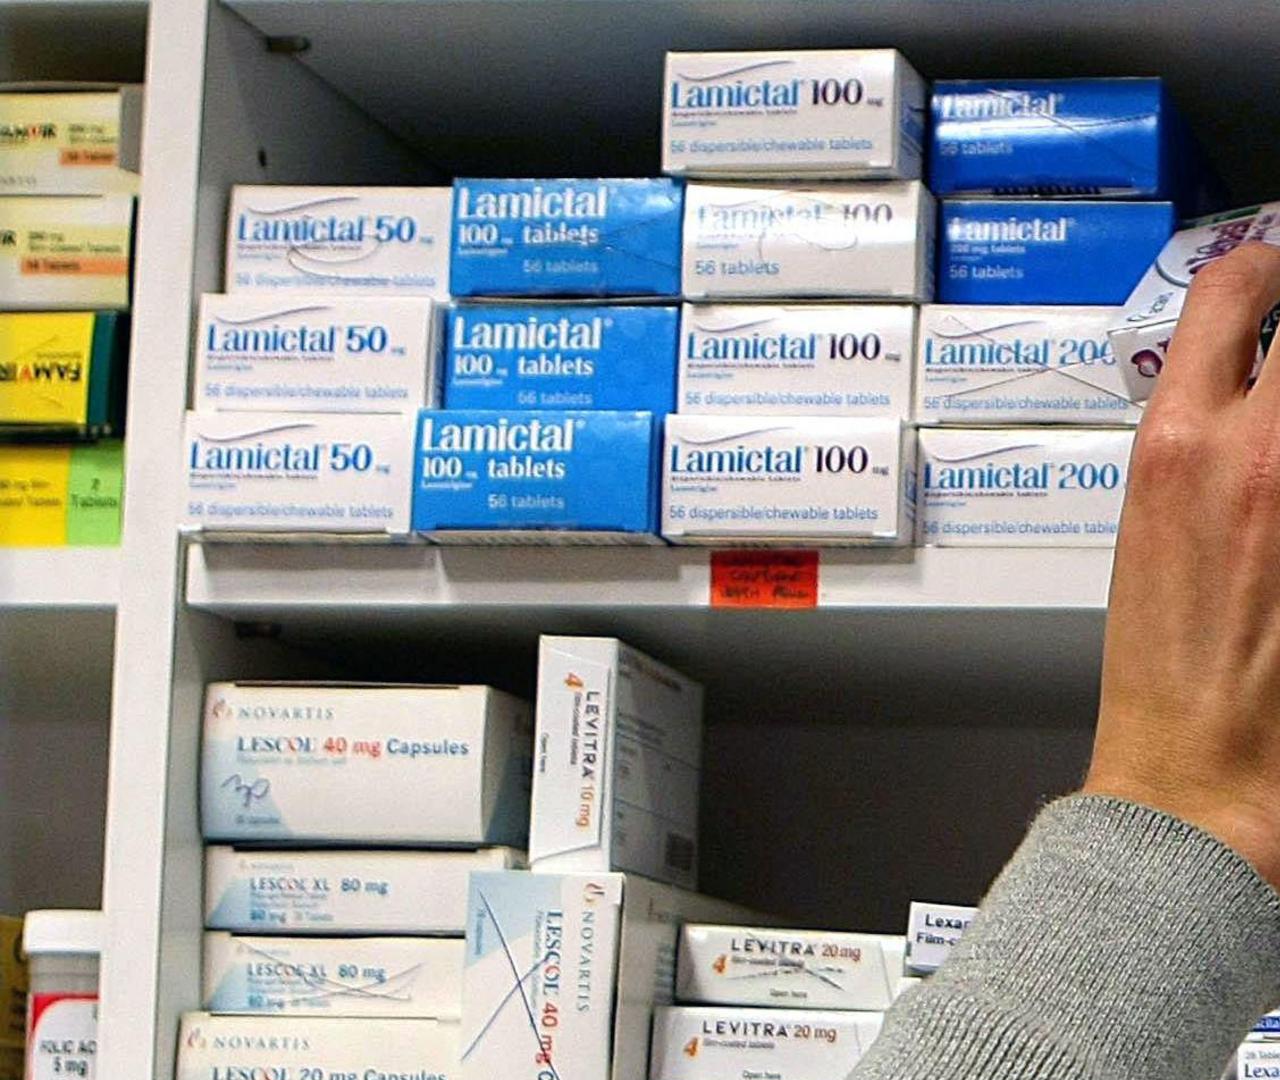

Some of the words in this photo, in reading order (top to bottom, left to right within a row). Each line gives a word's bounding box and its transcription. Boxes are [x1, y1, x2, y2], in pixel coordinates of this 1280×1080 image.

[671, 80, 801, 108] Lamictal
[812, 79, 863, 106] 100
[207, 324, 336, 353] Lamictal
[346, 326, 387, 352] 50
[422, 417, 574, 452] Lamictal
[422, 458, 463, 477] 100
[487, 458, 565, 479] tablets
[670, 445, 802, 474] Lamictal
[815, 445, 868, 473] 100
[670, 506, 686, 519] 56
[833, 506, 878, 519] tablets
[237, 707, 334, 720] NOVARTIS
[237, 737, 317, 754] LESCOL
[323, 738, 347, 754] 40
[352, 740, 381, 758] mg
[387, 738, 469, 757] Capsules
[579, 691, 600, 780] LEVITRA
[577, 911, 593, 1013] NOVARTIS
[703, 1020, 788, 1037] LEVITRA
[794, 1025, 810, 1039] 20
[815, 1028, 837, 1042] mg
